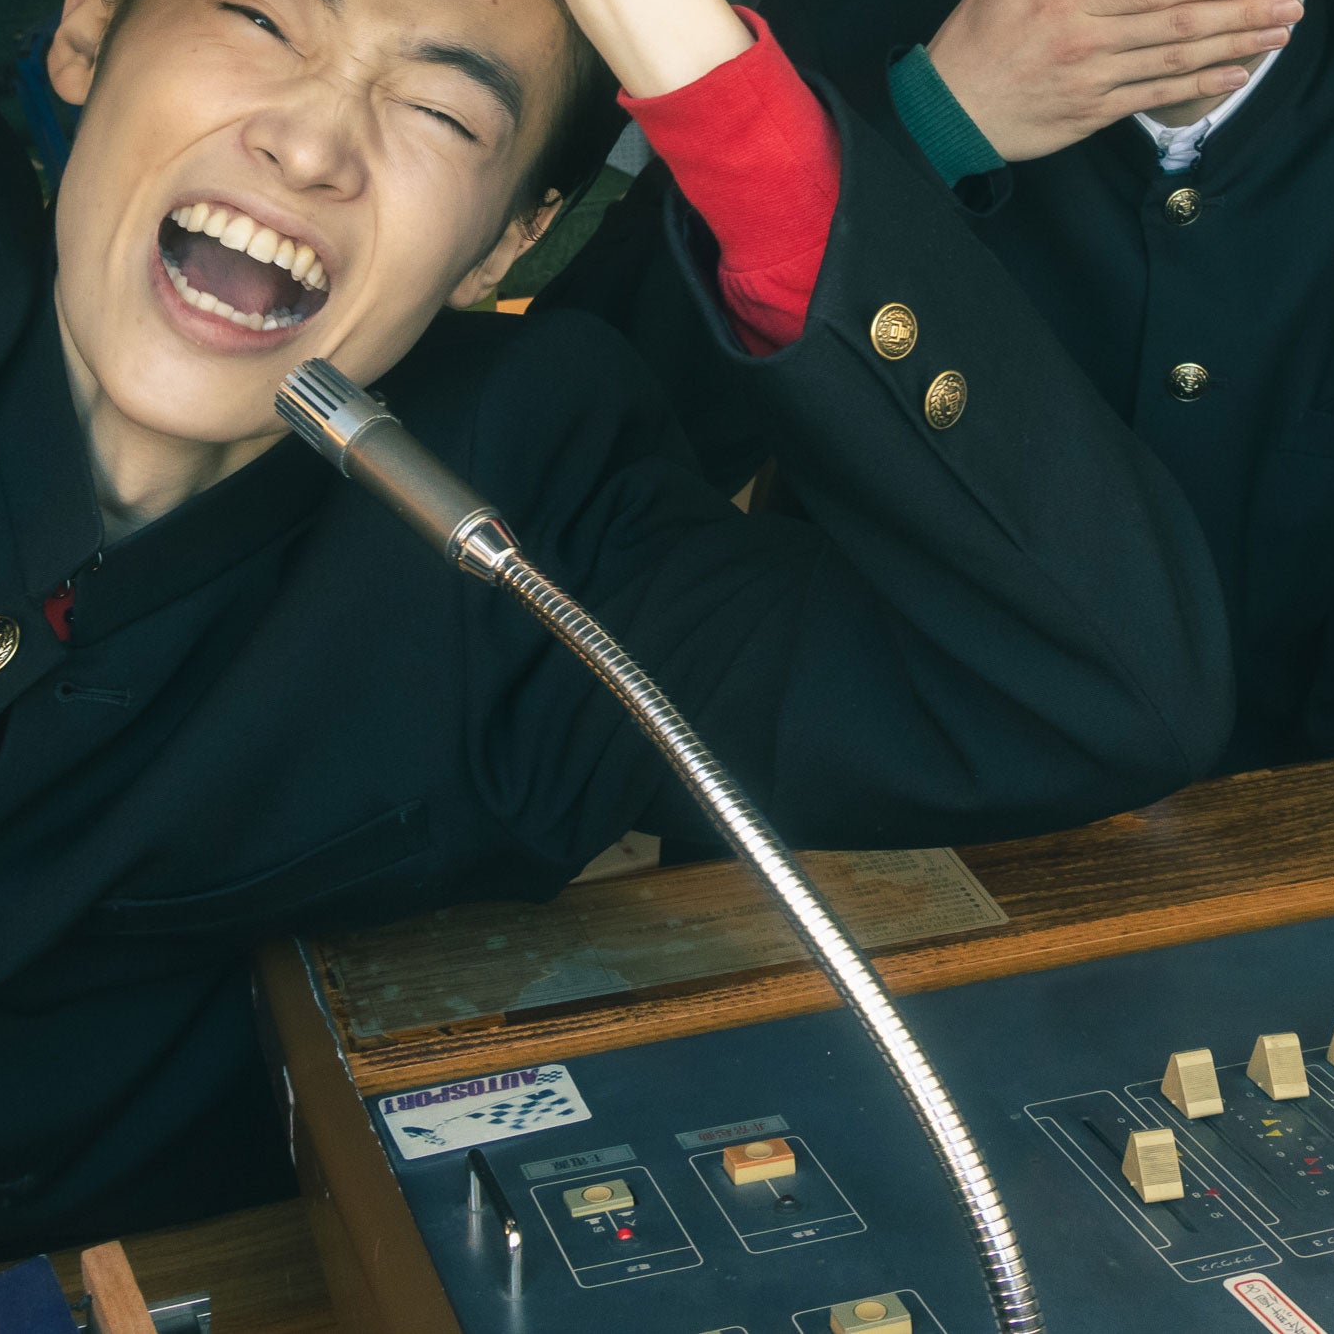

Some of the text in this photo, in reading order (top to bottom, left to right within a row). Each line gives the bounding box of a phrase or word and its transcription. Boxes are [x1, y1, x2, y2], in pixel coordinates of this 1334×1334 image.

[382, 1068, 539, 1115] AUTOSPORT
[1197, 1254, 1255, 1272] アナウンス
